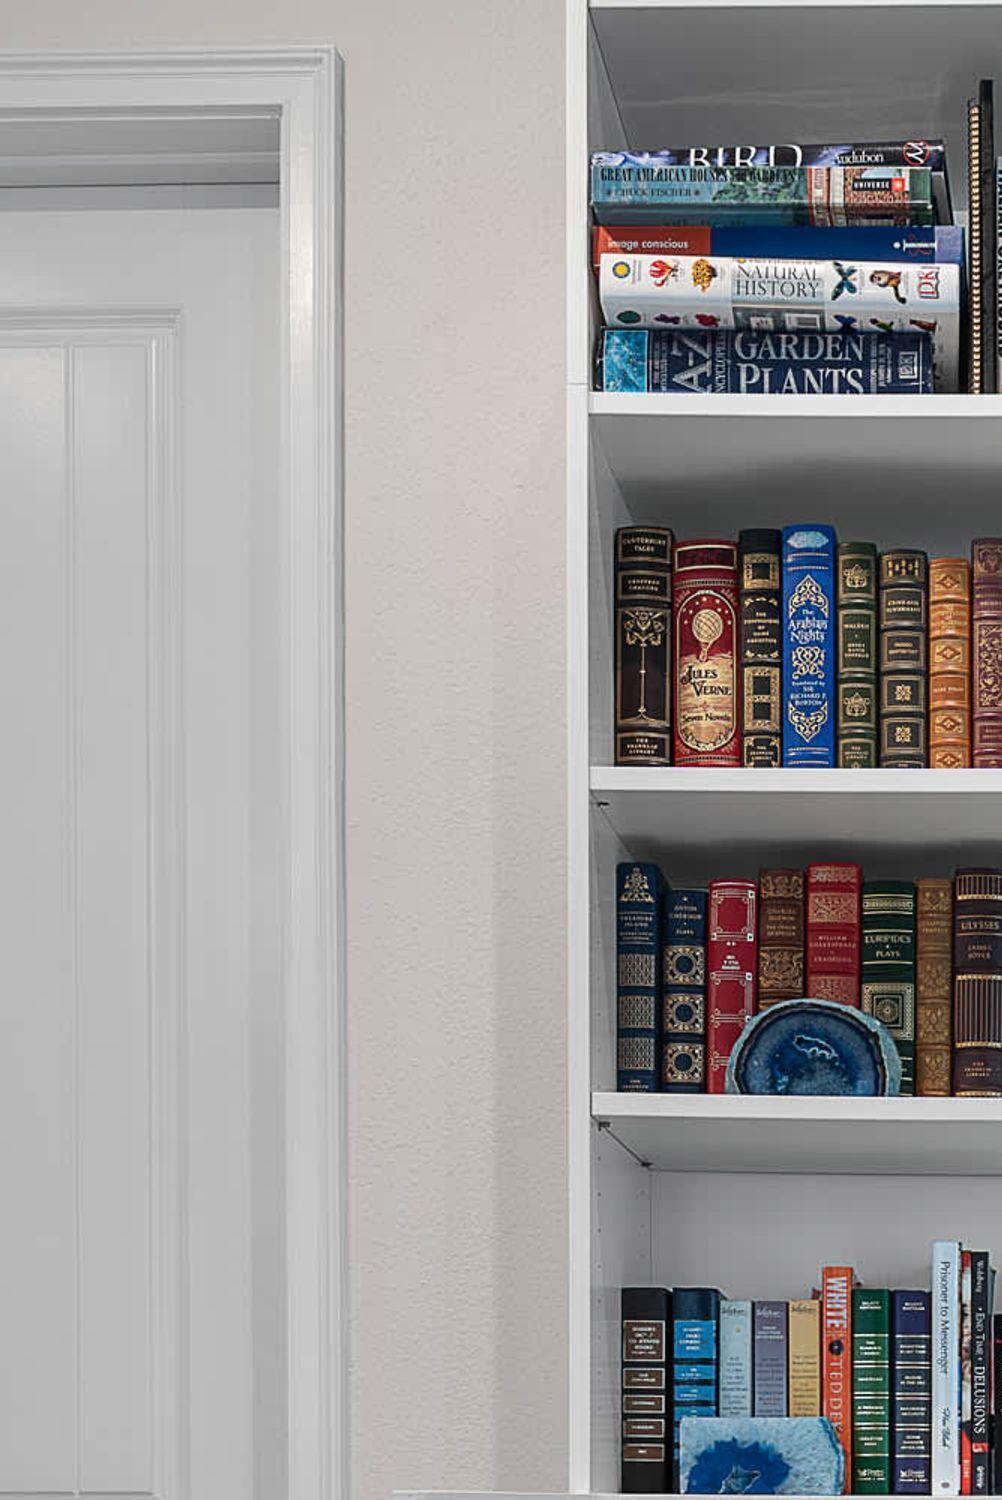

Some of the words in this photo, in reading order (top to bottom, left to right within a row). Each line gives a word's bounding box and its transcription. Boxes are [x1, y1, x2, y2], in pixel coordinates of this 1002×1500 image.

[601, 168, 633, 183] GREAT
[634, 168, 688, 183] AMERICAN
[854, 181, 891, 190] UNIVERSE
[608, 238, 638, 250] image
[641, 238, 689, 249] conscious
[737, 263, 820, 281] NATURAL
[736, 281, 820, 300] HISTORY
[735, 332, 864, 361] GARDEN
[738, 363, 865, 394] PLANTS
[788, 618, 828, 631] Arabian
[790, 630, 826, 644] Nights
[681, 666, 718, 684] JULES
[693, 678, 732, 697] VERNE
[682, 713, 704, 723] Seven
[705, 713, 731, 722] Novels
[961, 920, 999, 930] ULYSSES
[968, 952, 991, 960] JOYCE
[940, 1261, 951, 1303] Prisoner
[827, 1277, 848, 1329] WHITE
[938, 1320, 950, 1375] Messenger
[830, 1360, 843, 1393] TED
[974, 1367, 986, 1434] DELUSIONS
